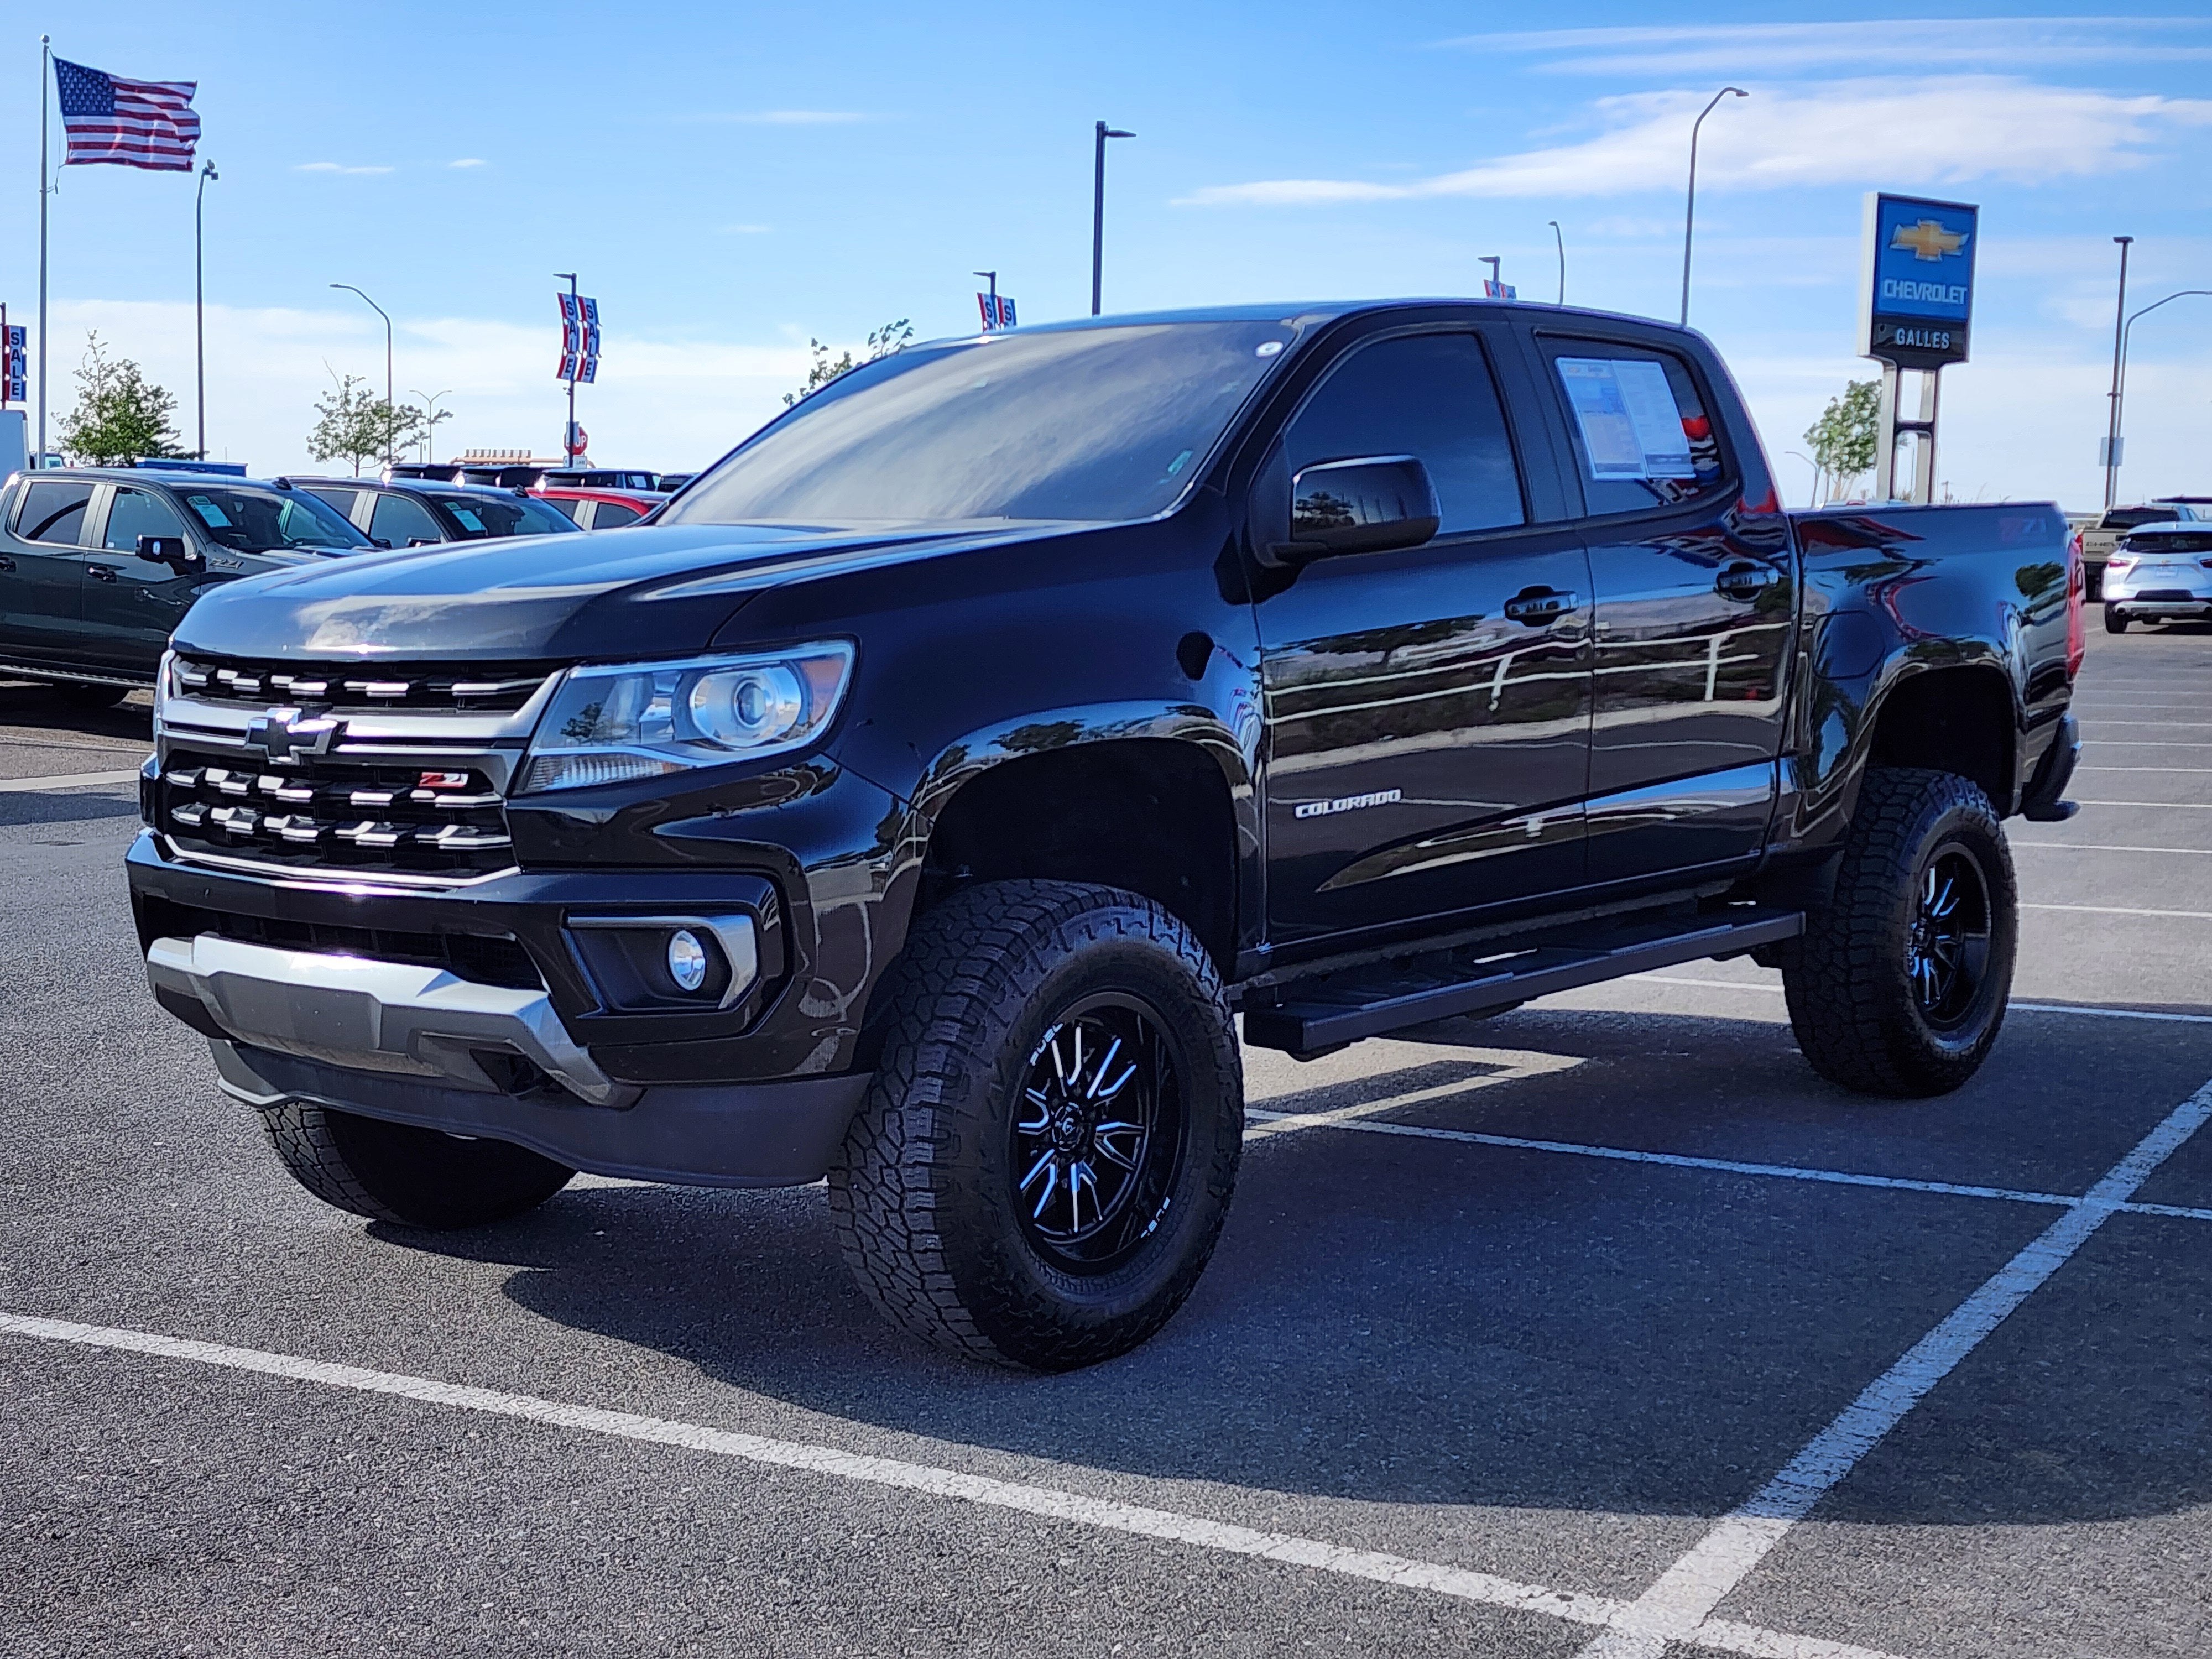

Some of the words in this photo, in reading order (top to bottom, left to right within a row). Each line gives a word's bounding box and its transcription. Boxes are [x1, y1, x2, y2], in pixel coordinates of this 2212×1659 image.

[1883, 278, 1967, 304] CHEVROLET
[565, 300, 577, 374] SALE
[585, 304, 596, 376] SALE
[1896, 327, 1950, 349] GALLES
[11, 332, 21, 396] SALE
[1295, 789, 1401, 818] COLORADO
[1030, 1023, 1063, 1066] FUEL
